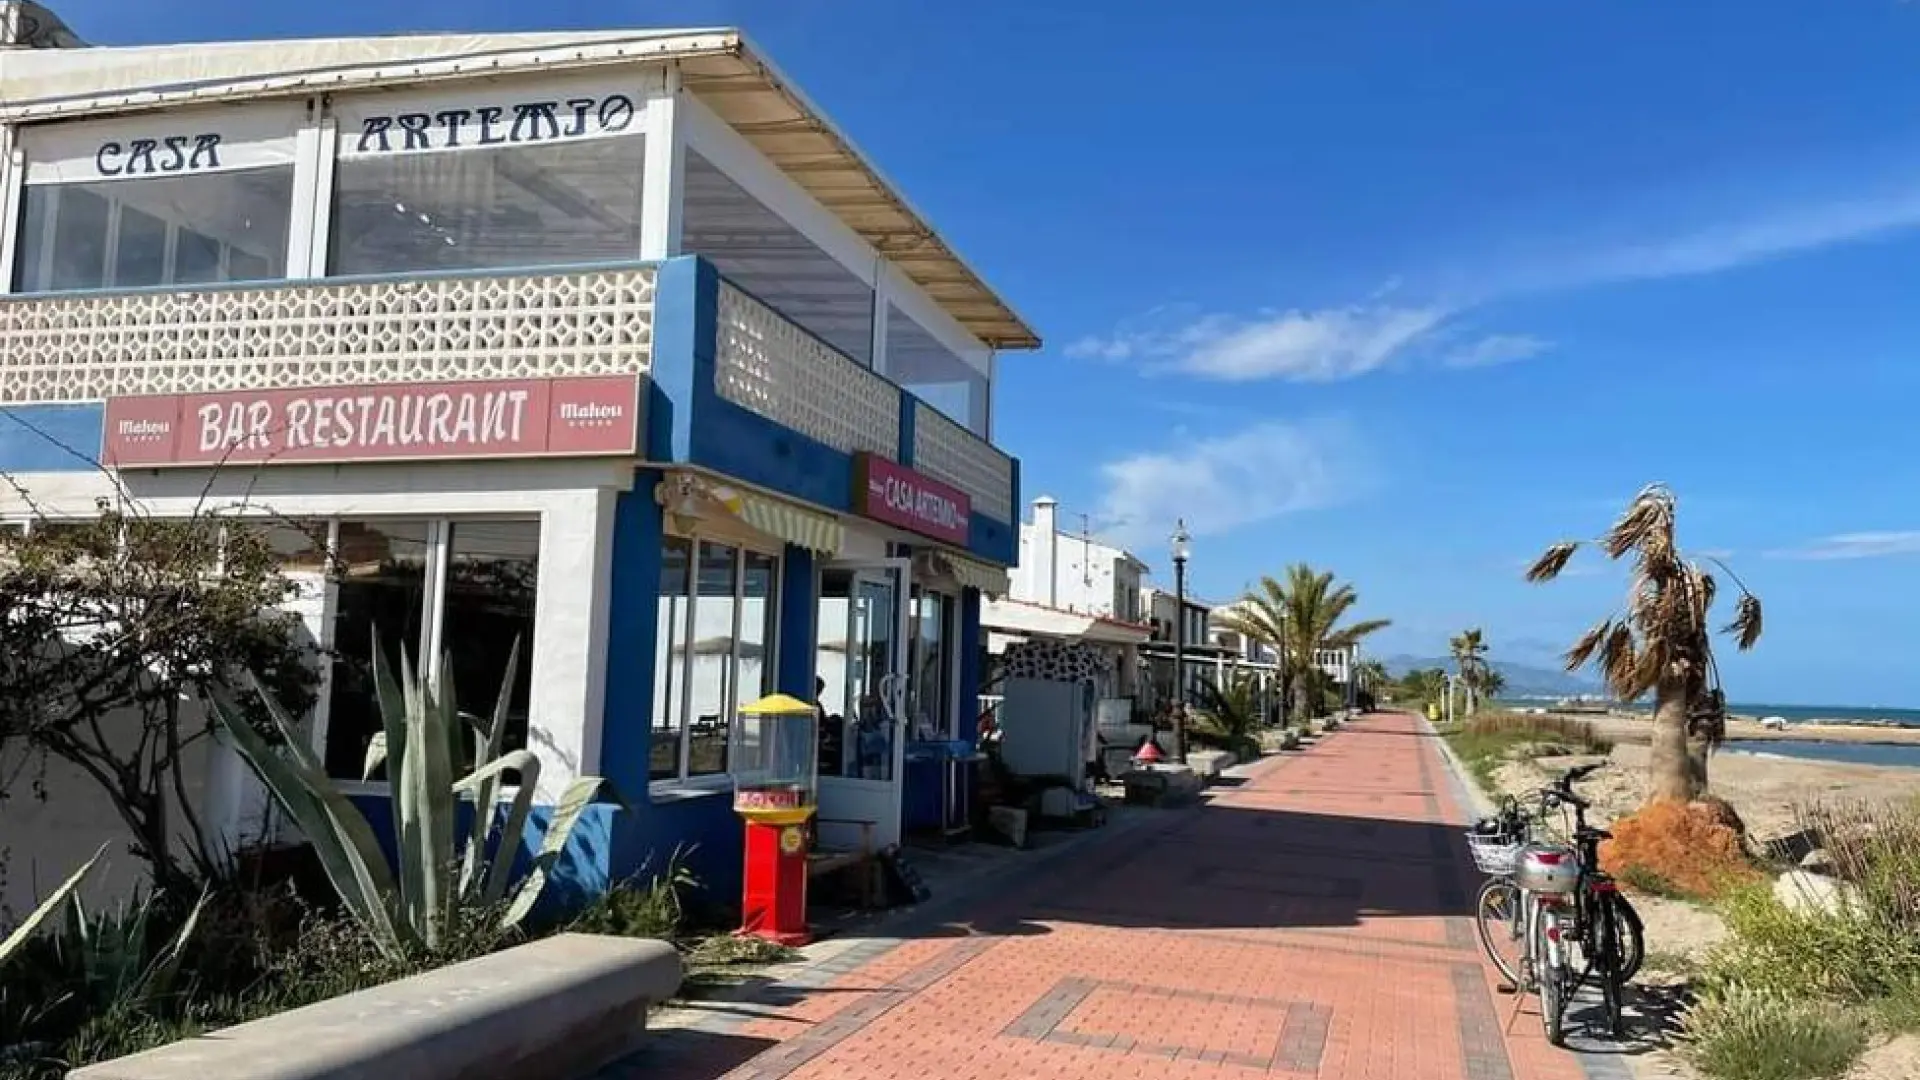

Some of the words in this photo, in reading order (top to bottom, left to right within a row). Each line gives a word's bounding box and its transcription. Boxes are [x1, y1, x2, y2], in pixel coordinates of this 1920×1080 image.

[96, 132, 222, 176] CASA
[119, 420, 170, 435] Mahou
[198, 400, 273, 452] BAR
[285, 389, 529, 449] RESTAURANT
[560, 402, 623, 418] Mahou
[885, 475, 913, 515] CASA
